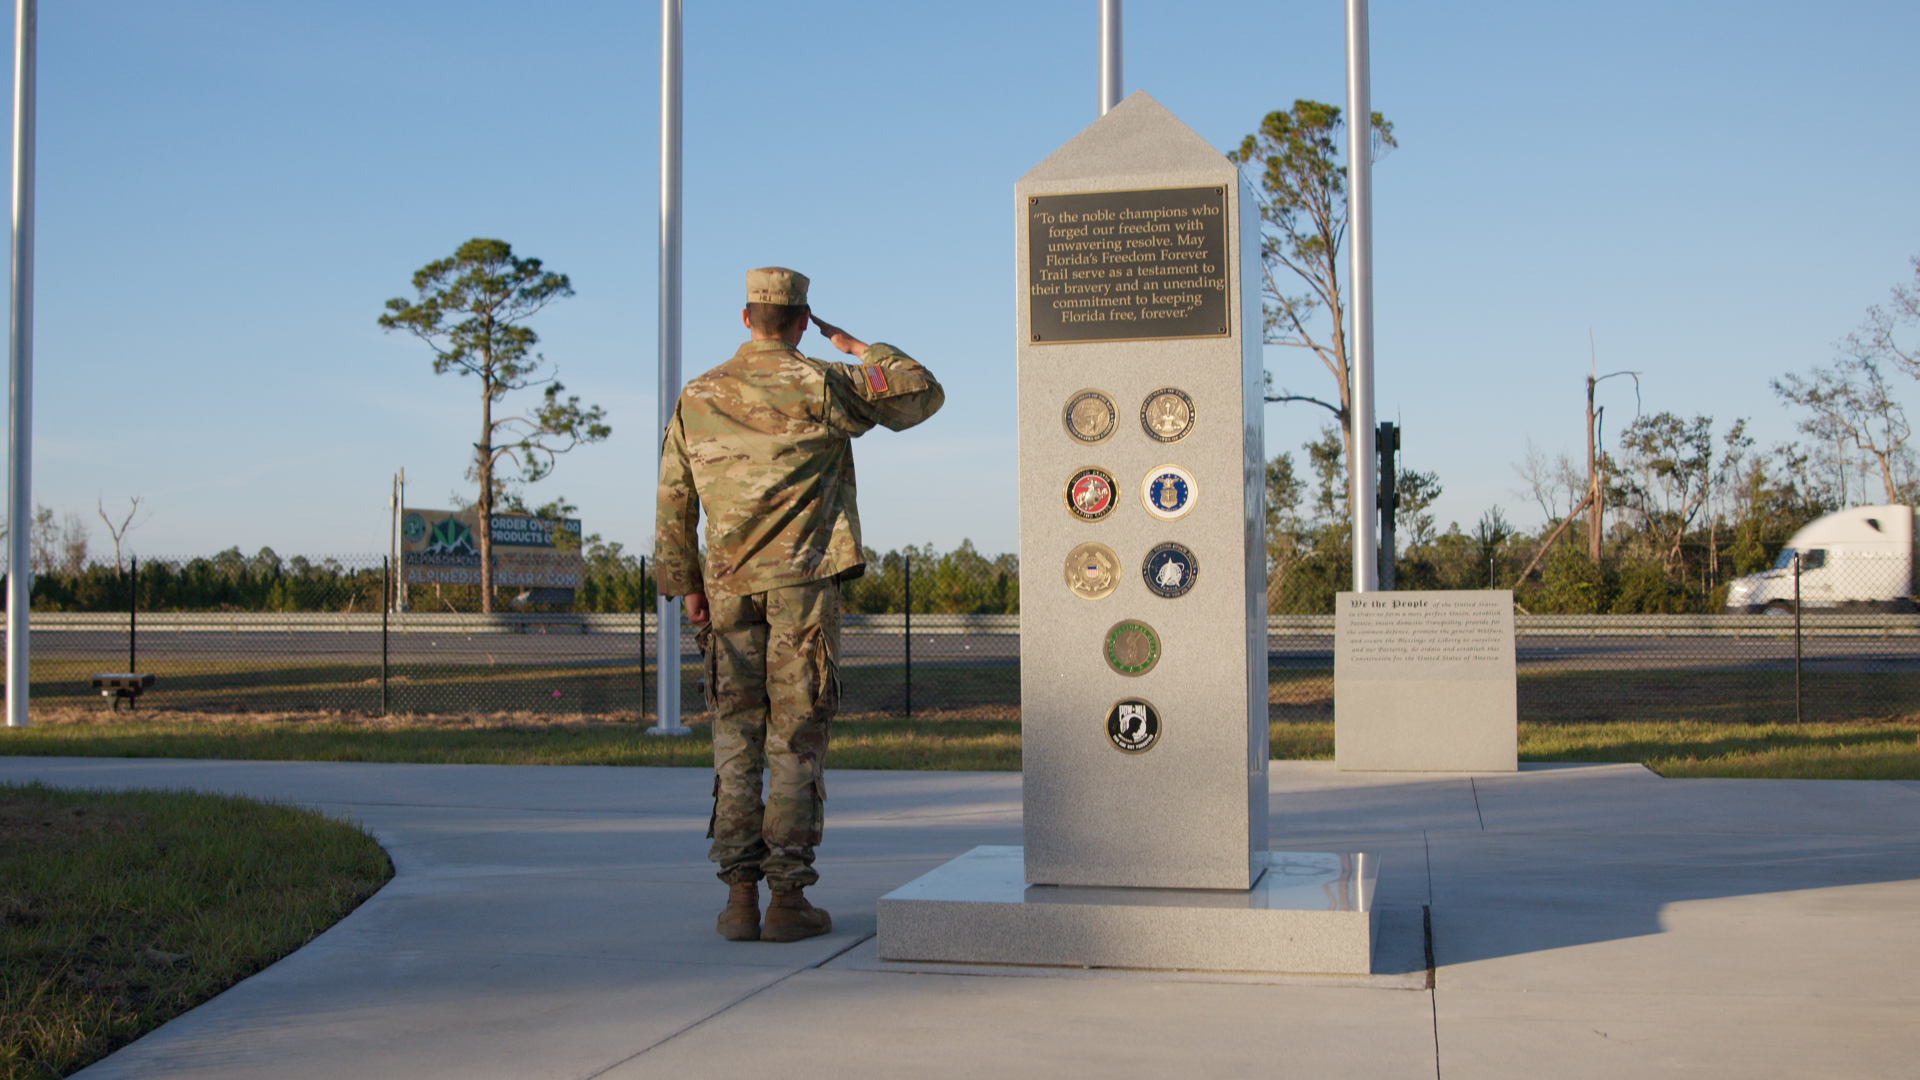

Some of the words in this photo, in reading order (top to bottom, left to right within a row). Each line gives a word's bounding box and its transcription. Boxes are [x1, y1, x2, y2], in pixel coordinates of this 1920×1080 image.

[1034, 212, 1054, 224] “To
[1060, 212, 1078, 223] the
[1083, 209, 1115, 222] noble
[1120, 207, 1187, 222] champions
[1192, 205, 1219, 216] who
[1049, 225, 1087, 240] forged
[1093, 226, 1113, 235] our
[1119, 222, 1170, 234] freedom
[1175, 220, 1203, 232] with
[1048, 238, 1122, 252] unwavering
[1127, 235, 1172, 248] resolve.
[1178, 234, 1205, 249] May
[1046, 254, 1097, 266] Florida’s
[1102, 251, 1156, 264] Freedom
[1161, 249, 1208, 260] Forever
[1040, 268, 1068, 281] Trail
[1072, 269, 1104, 279] serve
[1109, 268, 1122, 277] as
[1127, 267, 1132, 276] a
[1138, 264, 1198, 276] testament
[1203, 263, 1214, 274] to
[1032, 282, 1060, 296] their
[1065, 280, 1111, 296] bravery
[1116, 280, 1138, 292] and
[1143, 280, 1158, 290] an
[1164, 277, 1224, 291] unending
[1053, 296, 1131, 309] commitment
[1136, 295, 1147, 305] to
[1152, 292, 1202, 307] keeping
[1062, 310, 1105, 323] Florida
[1110, 307, 1136, 322] free,
[1142, 306, 1193, 319] forever.”
[491, 518, 527, 530] ORDER
[492, 531, 542, 543] PRODUCTS
[408, 569, 576, 586] ALPINEDISENSARY.COM
[1351, 600, 1367, 608] We
[1372, 600, 1386, 608] the
[1392, 600, 1428, 609] People
[1119, 705, 1132, 721] POW
[1135, 705, 1146, 721] MIA
[1118, 740, 1126, 748] ARE
[1136, 734, 1154, 750] FORGOTTEN
